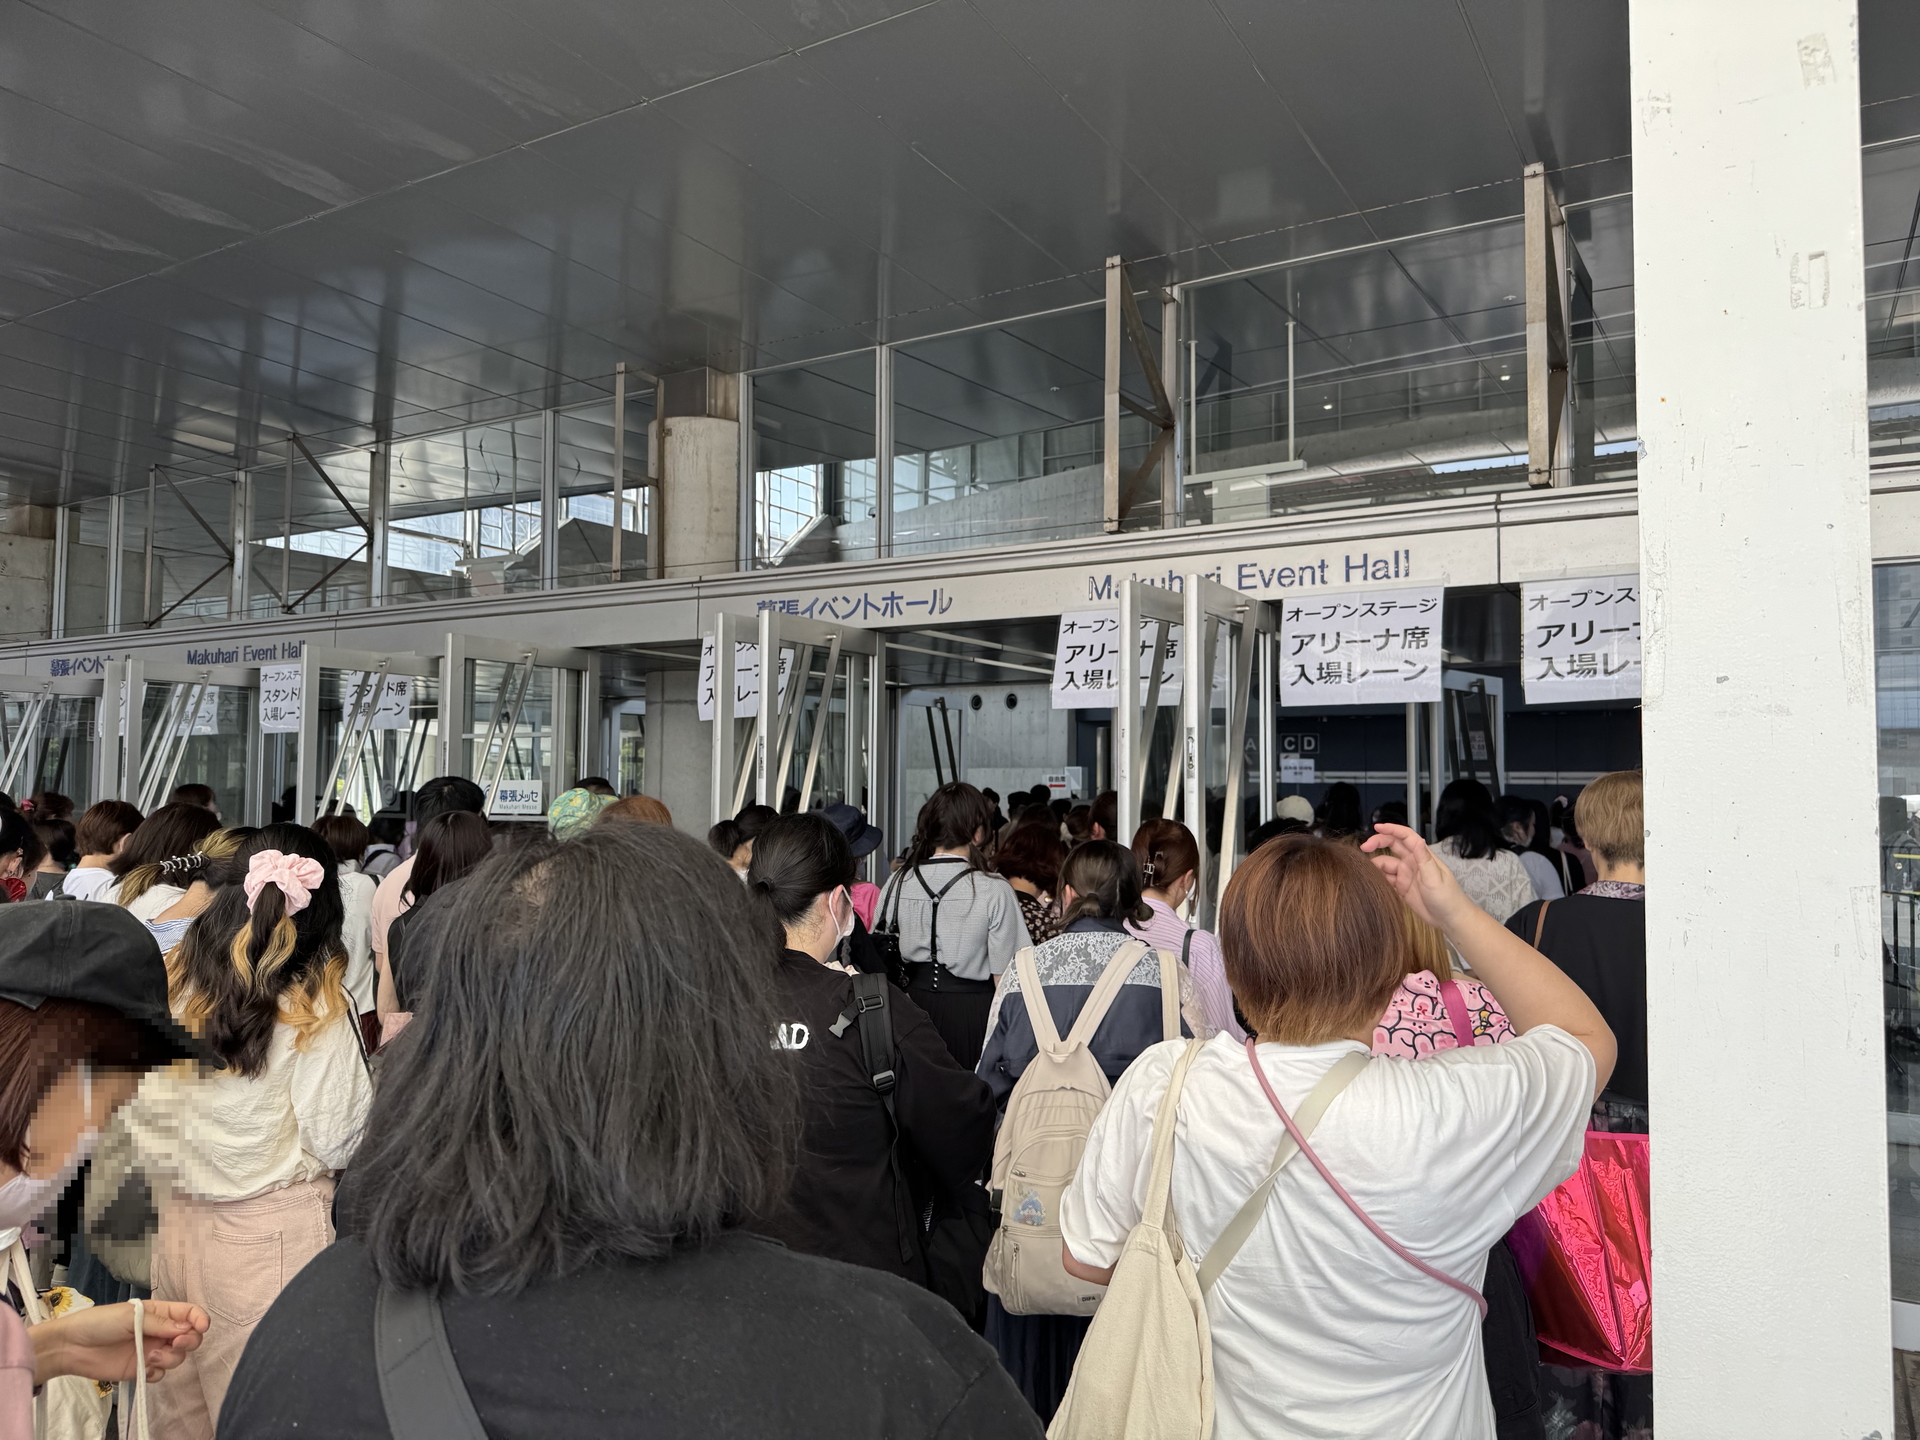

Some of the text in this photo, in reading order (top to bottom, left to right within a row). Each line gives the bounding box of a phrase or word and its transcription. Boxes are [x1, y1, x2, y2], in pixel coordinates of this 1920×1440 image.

[1237, 558, 1328, 590] Event
[1344, 549, 1410, 582] Hall
[1286, 598, 1438, 622] オープンステージ
[1528, 587, 1640, 611] オープンス
[187, 640, 306, 666] Makuhari Event Hal
[1291, 626, 1430, 656] アリーナ席
[262, 670, 301, 682] オープンステ
[1290, 659, 1429, 686] 入場レーン
[1536, 652, 1641, 680] 入場レ
[263, 687, 300, 703] スタンド
[263, 706, 300, 721] 入場レー
[1245, 737, 1315, 750] A C D
[499, 790, 538, 803] 幕張メッセ
